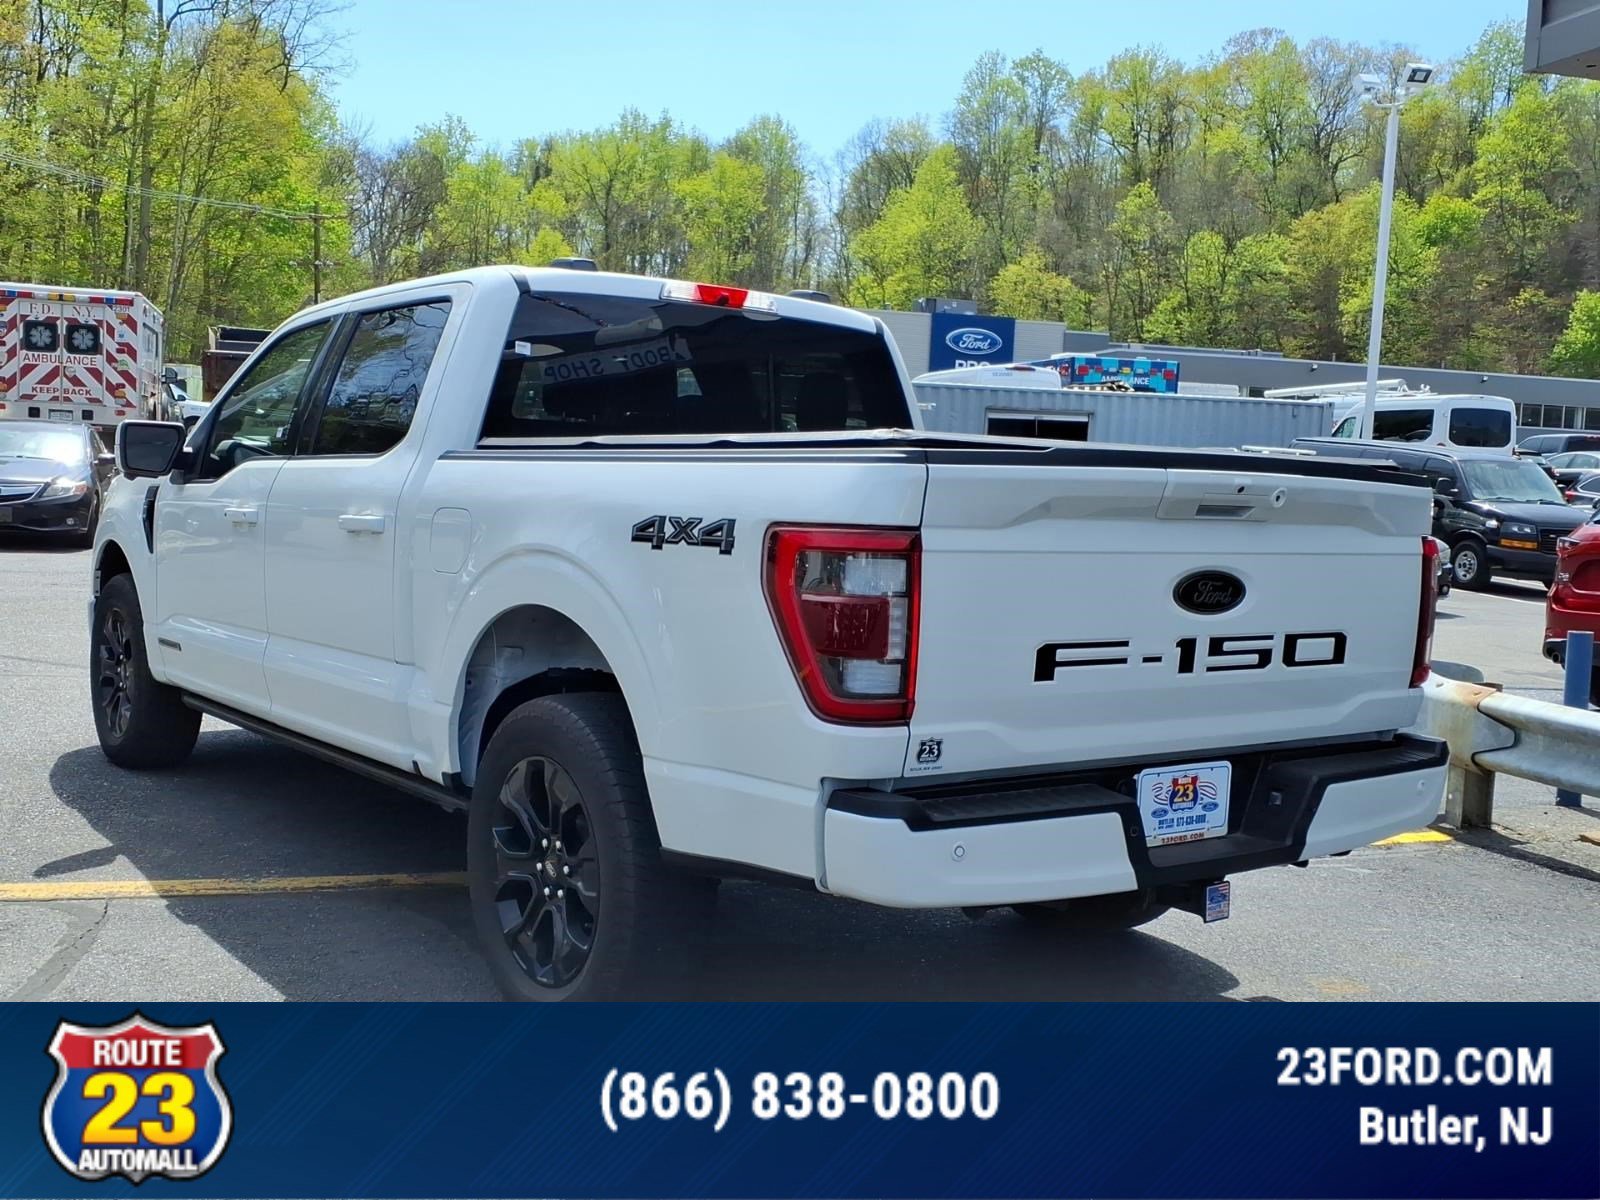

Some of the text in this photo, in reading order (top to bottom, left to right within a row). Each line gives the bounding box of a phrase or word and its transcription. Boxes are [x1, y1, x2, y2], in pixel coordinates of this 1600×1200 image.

[959, 333, 991, 350] Ford
[23, 352, 97, 366] AMBULANCE
[1101, 375, 1150, 385] AMBANCE
[31, 386, 92, 396] KEEP BACK
[1033, 631, 1348, 683] F-150
[920, 744, 939, 758] 23
[1173, 784, 1195, 802] 23
